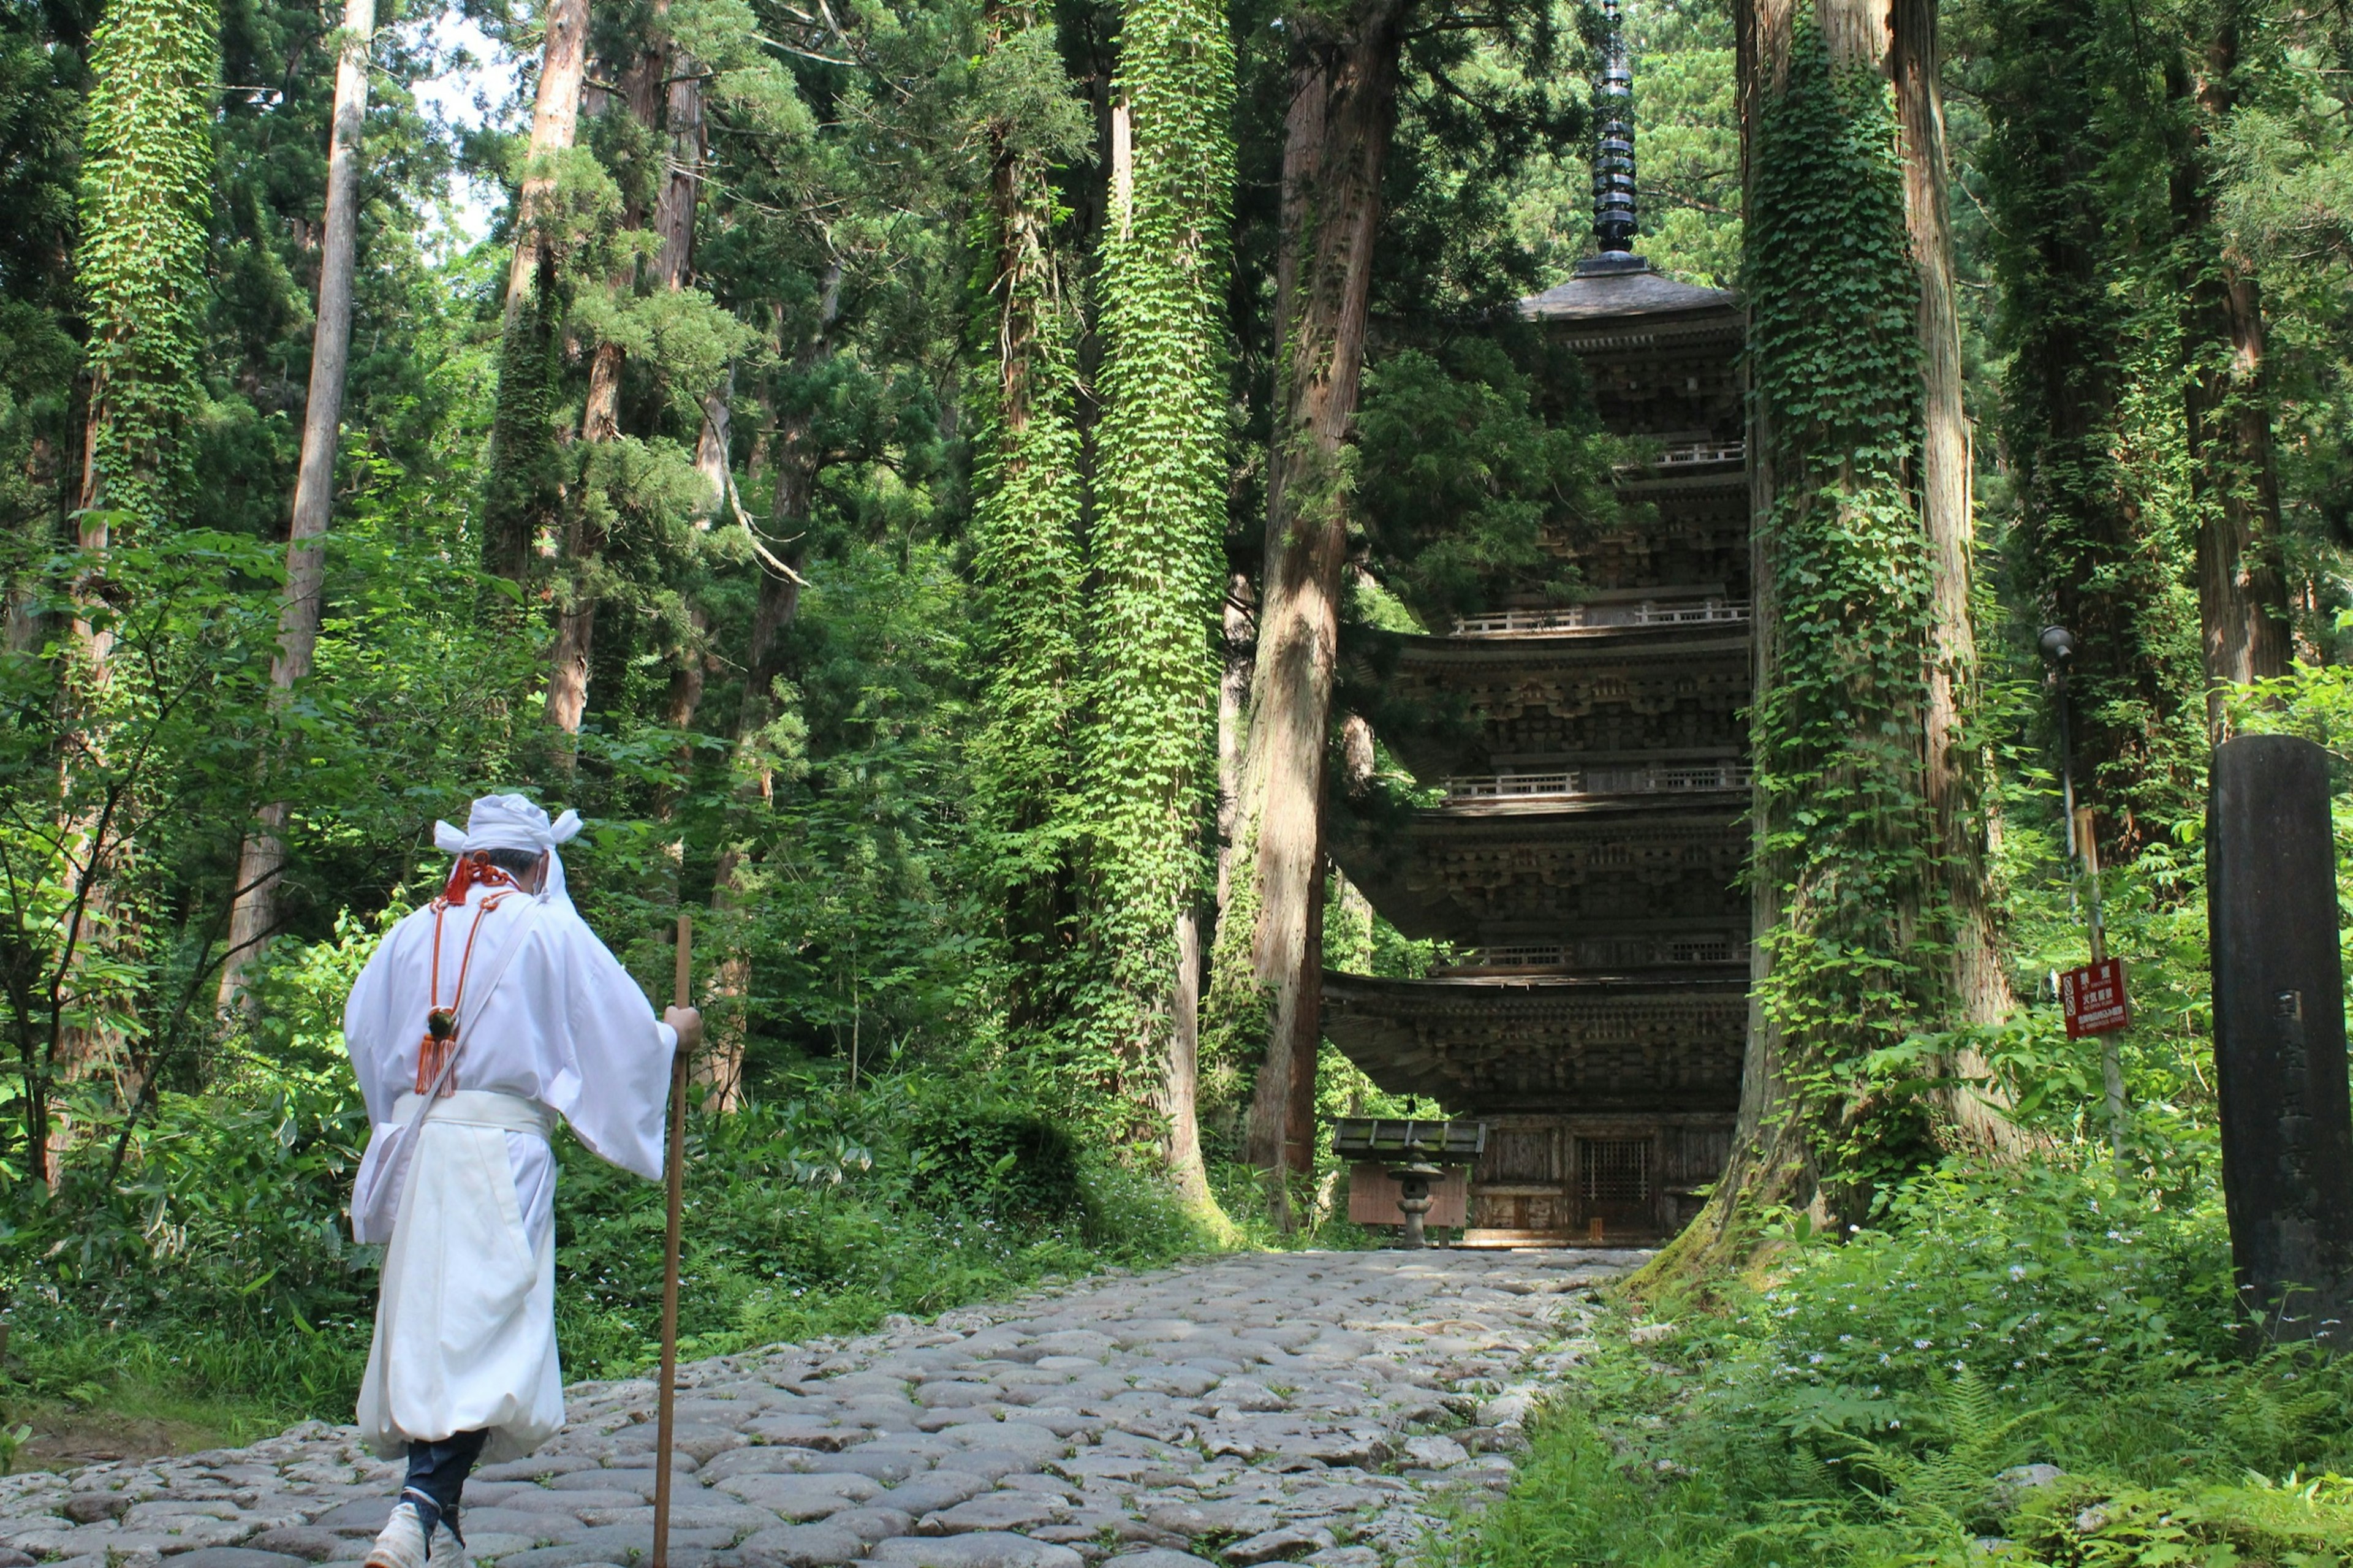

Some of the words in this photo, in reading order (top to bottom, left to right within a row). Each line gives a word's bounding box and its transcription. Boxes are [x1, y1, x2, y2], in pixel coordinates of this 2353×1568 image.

[2091, 979, 2112, 988] SMOKING
[2082, 987, 2113, 1006] 火気厳禁
[2110, 1015, 2125, 1024] GOODS
